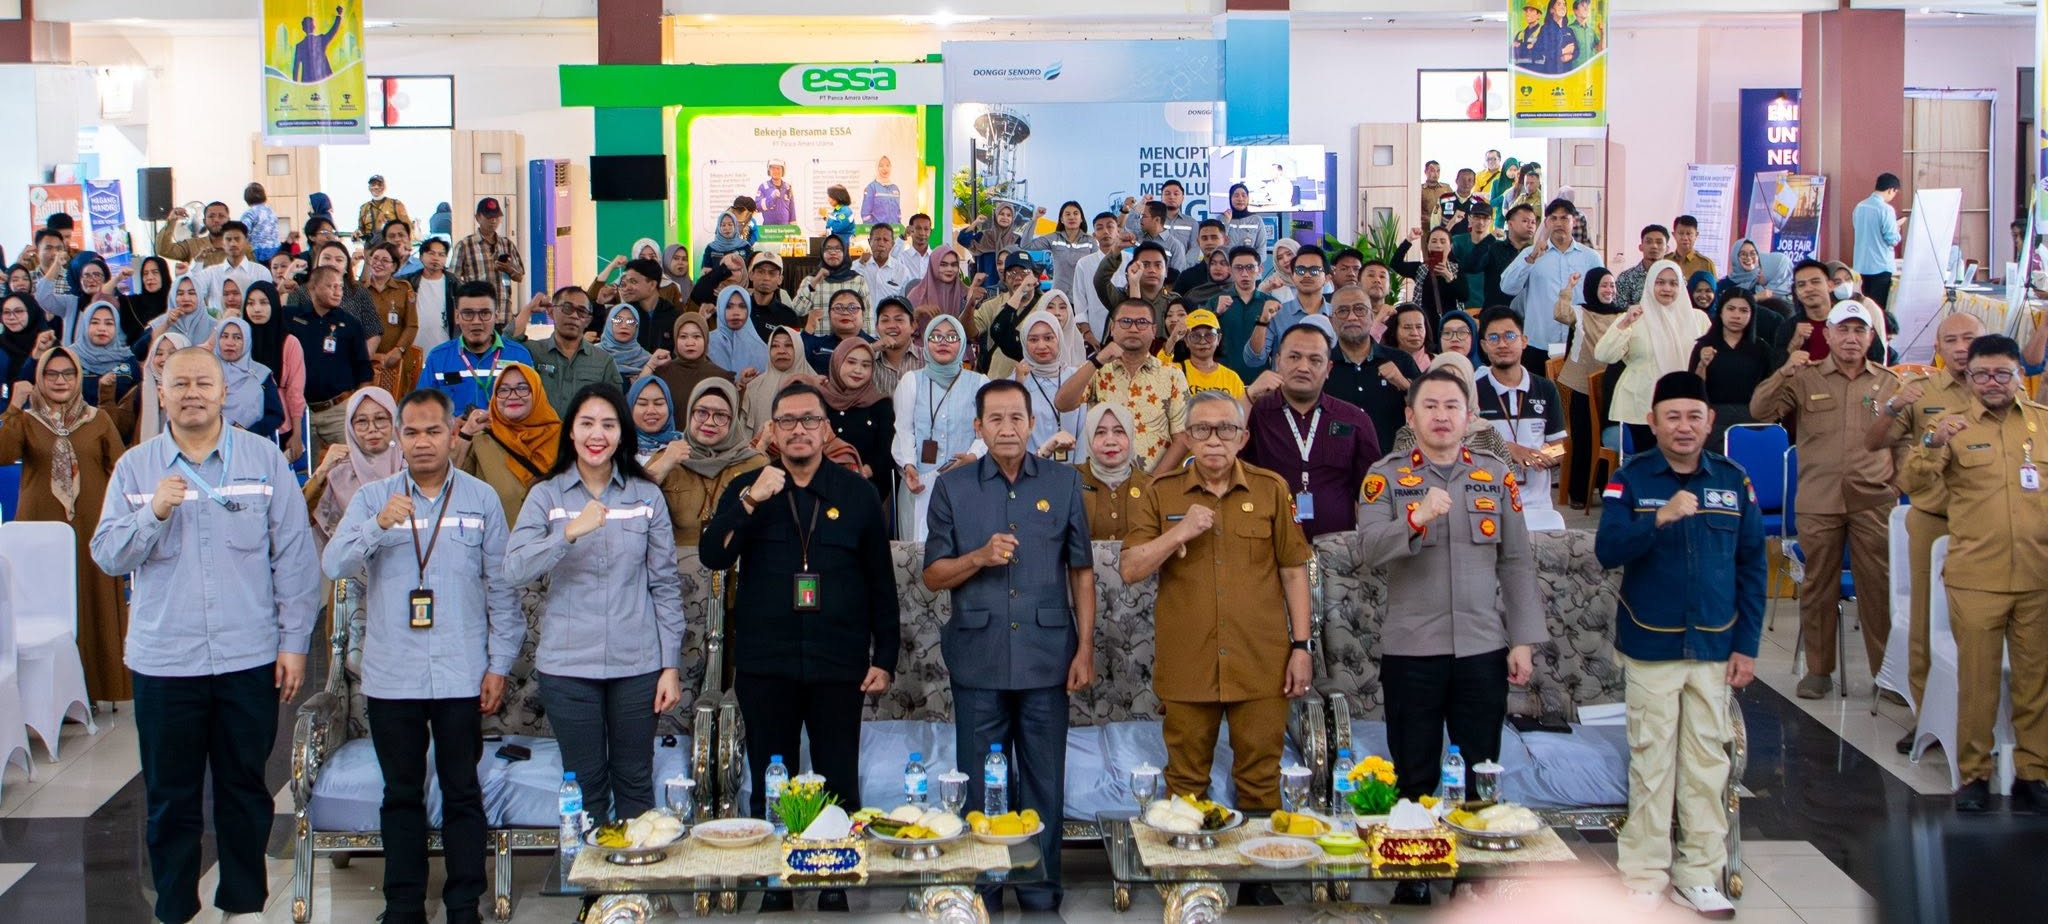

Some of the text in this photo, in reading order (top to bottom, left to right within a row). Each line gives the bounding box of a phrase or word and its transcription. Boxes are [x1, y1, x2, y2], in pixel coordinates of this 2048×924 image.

[973, 68, 1041, 76] DONGGI SENORO
[802, 67, 897, 93] essa
[754, 127, 852, 139] Bekerja Bersama ESSA
[1767, 126, 1799, 143] UN
[1777, 239, 1811, 251] JOB FAIR
[1465, 483, 1500, 493] POLRI
